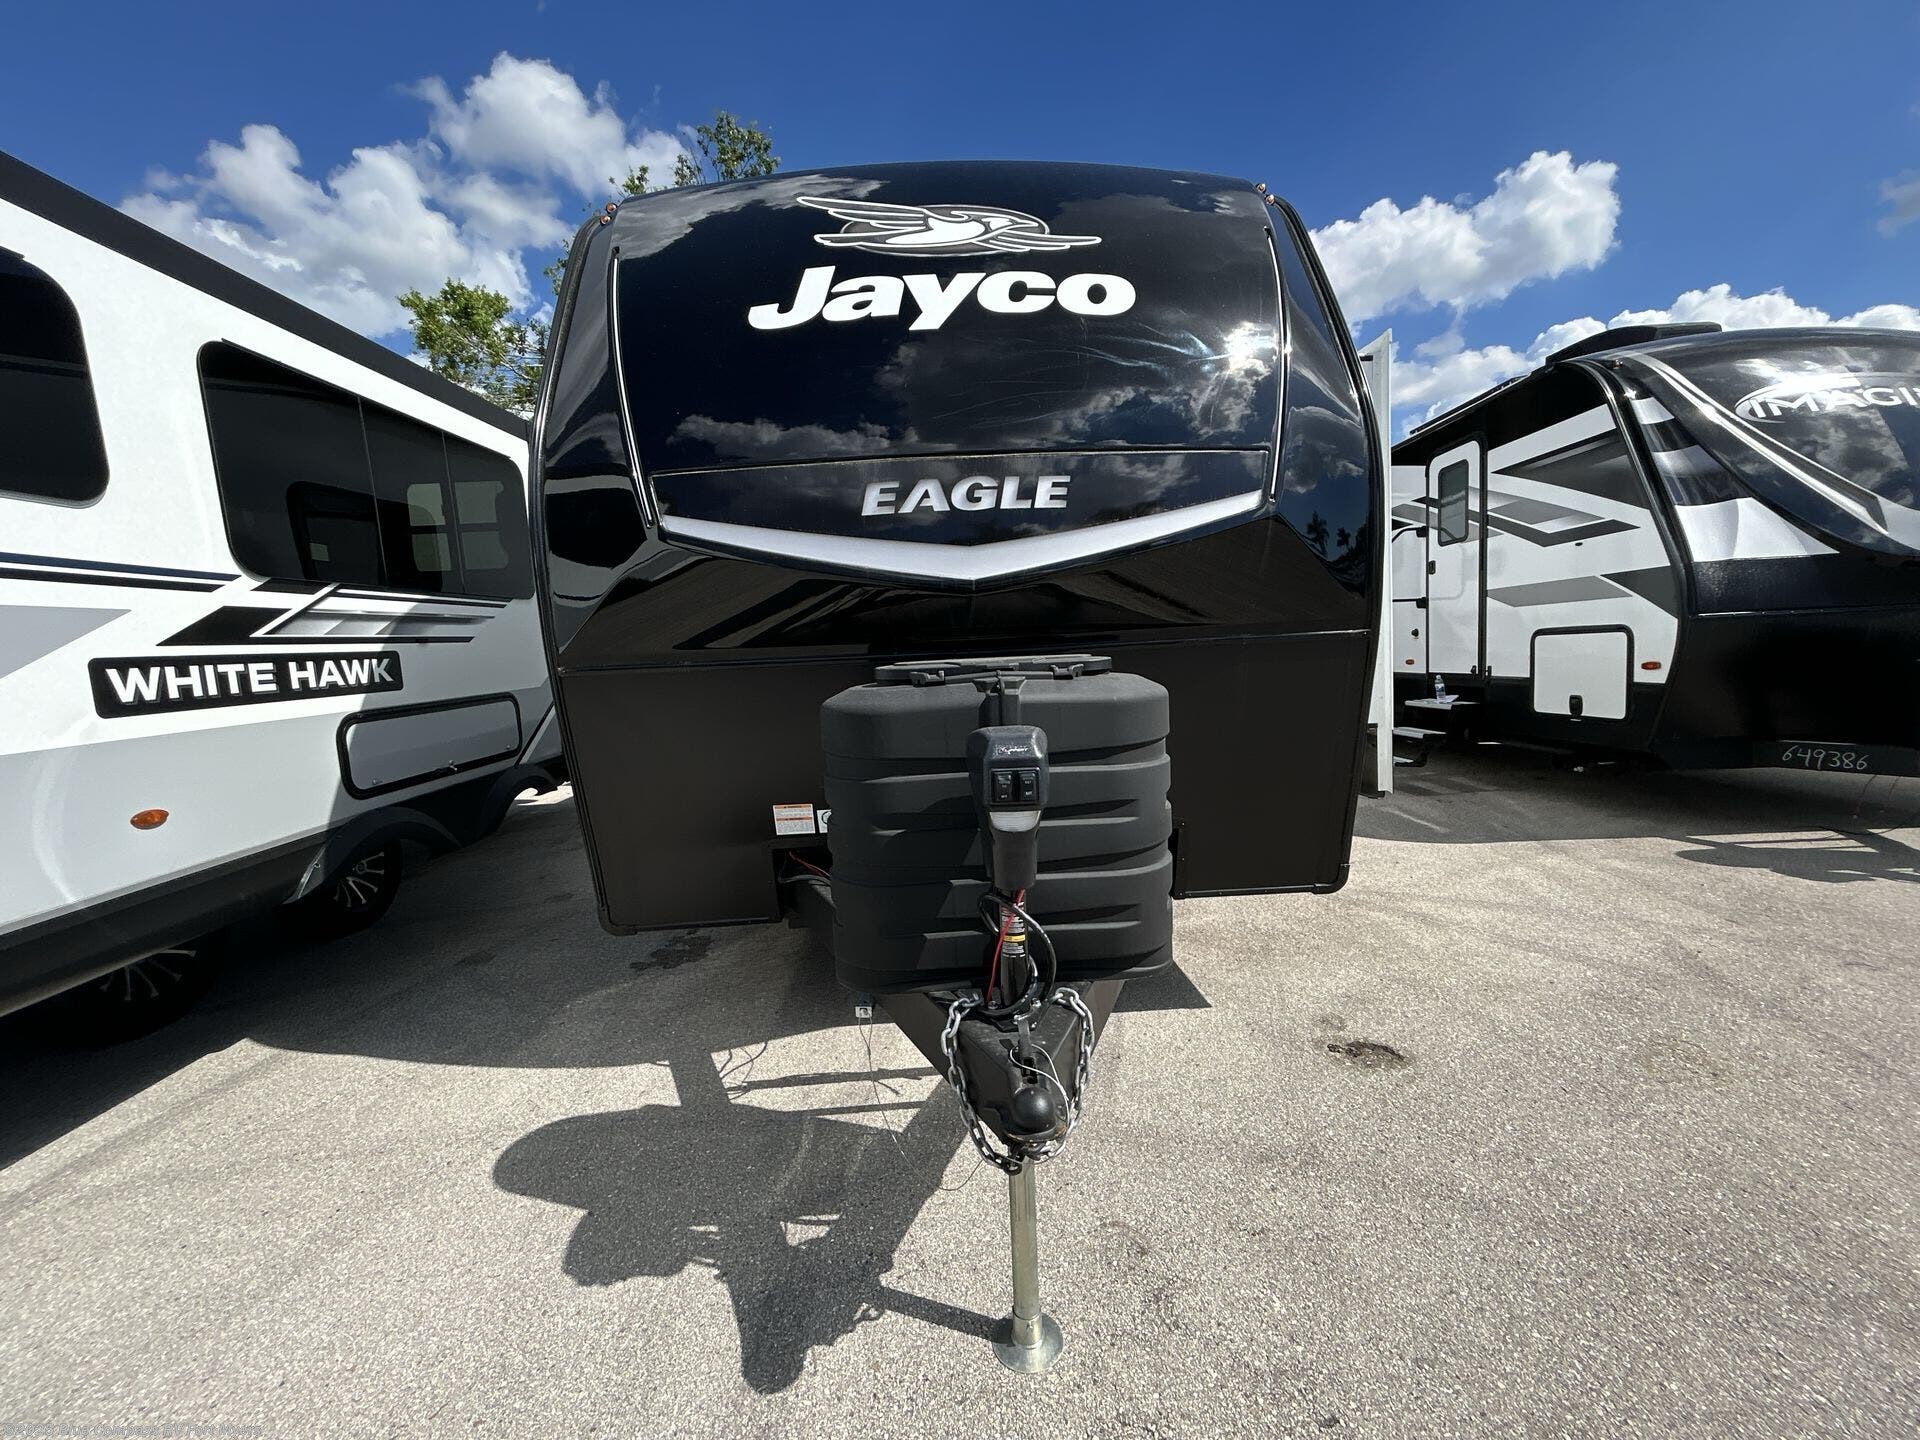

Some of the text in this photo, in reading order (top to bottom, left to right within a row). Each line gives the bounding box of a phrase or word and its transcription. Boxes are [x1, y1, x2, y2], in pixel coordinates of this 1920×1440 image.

[748, 265, 1137, 331] Jayco
[861, 475, 1071, 517] EAGLE
[105, 658, 395, 704] WHITE HAWK
[1782, 744, 1870, 770] 649386
